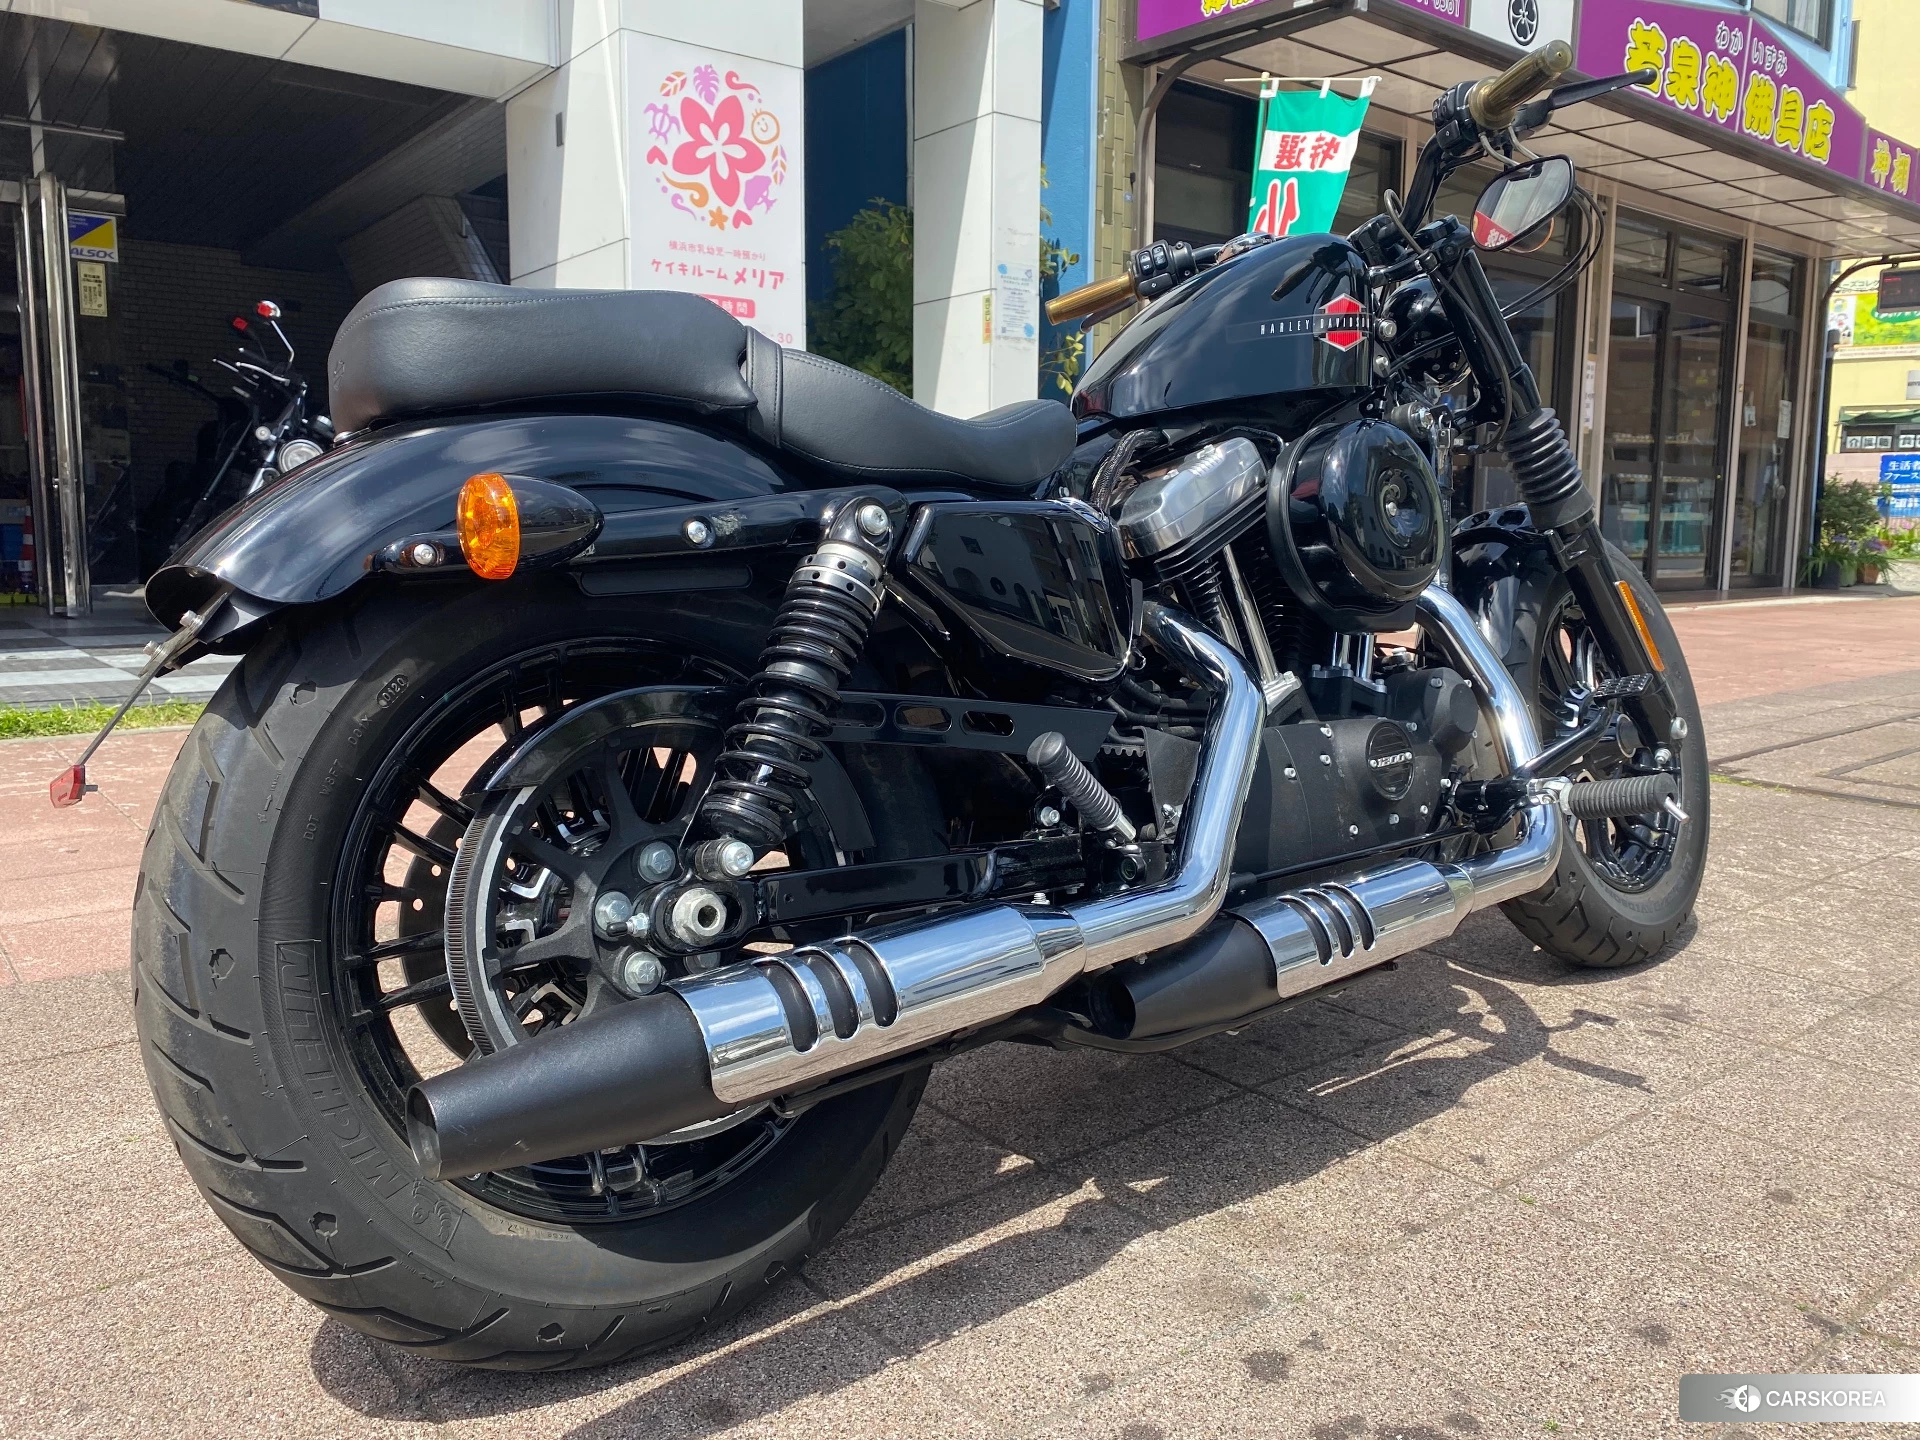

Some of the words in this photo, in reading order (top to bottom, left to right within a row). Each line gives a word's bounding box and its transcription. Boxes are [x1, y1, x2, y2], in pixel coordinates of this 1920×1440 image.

[1715, 19, 1744, 57] わか
[1751, 37, 1788, 78] いずみ
[70, 247, 115, 260] ALSOK
[669, 240, 766, 262] 横浜市乳幼児一時預かり
[651, 258, 728, 281] ケイキルーム
[734, 267, 785, 290] メリア
[712, 299, 748, 315] 時間
[1376, 752, 1406, 768] 1200
